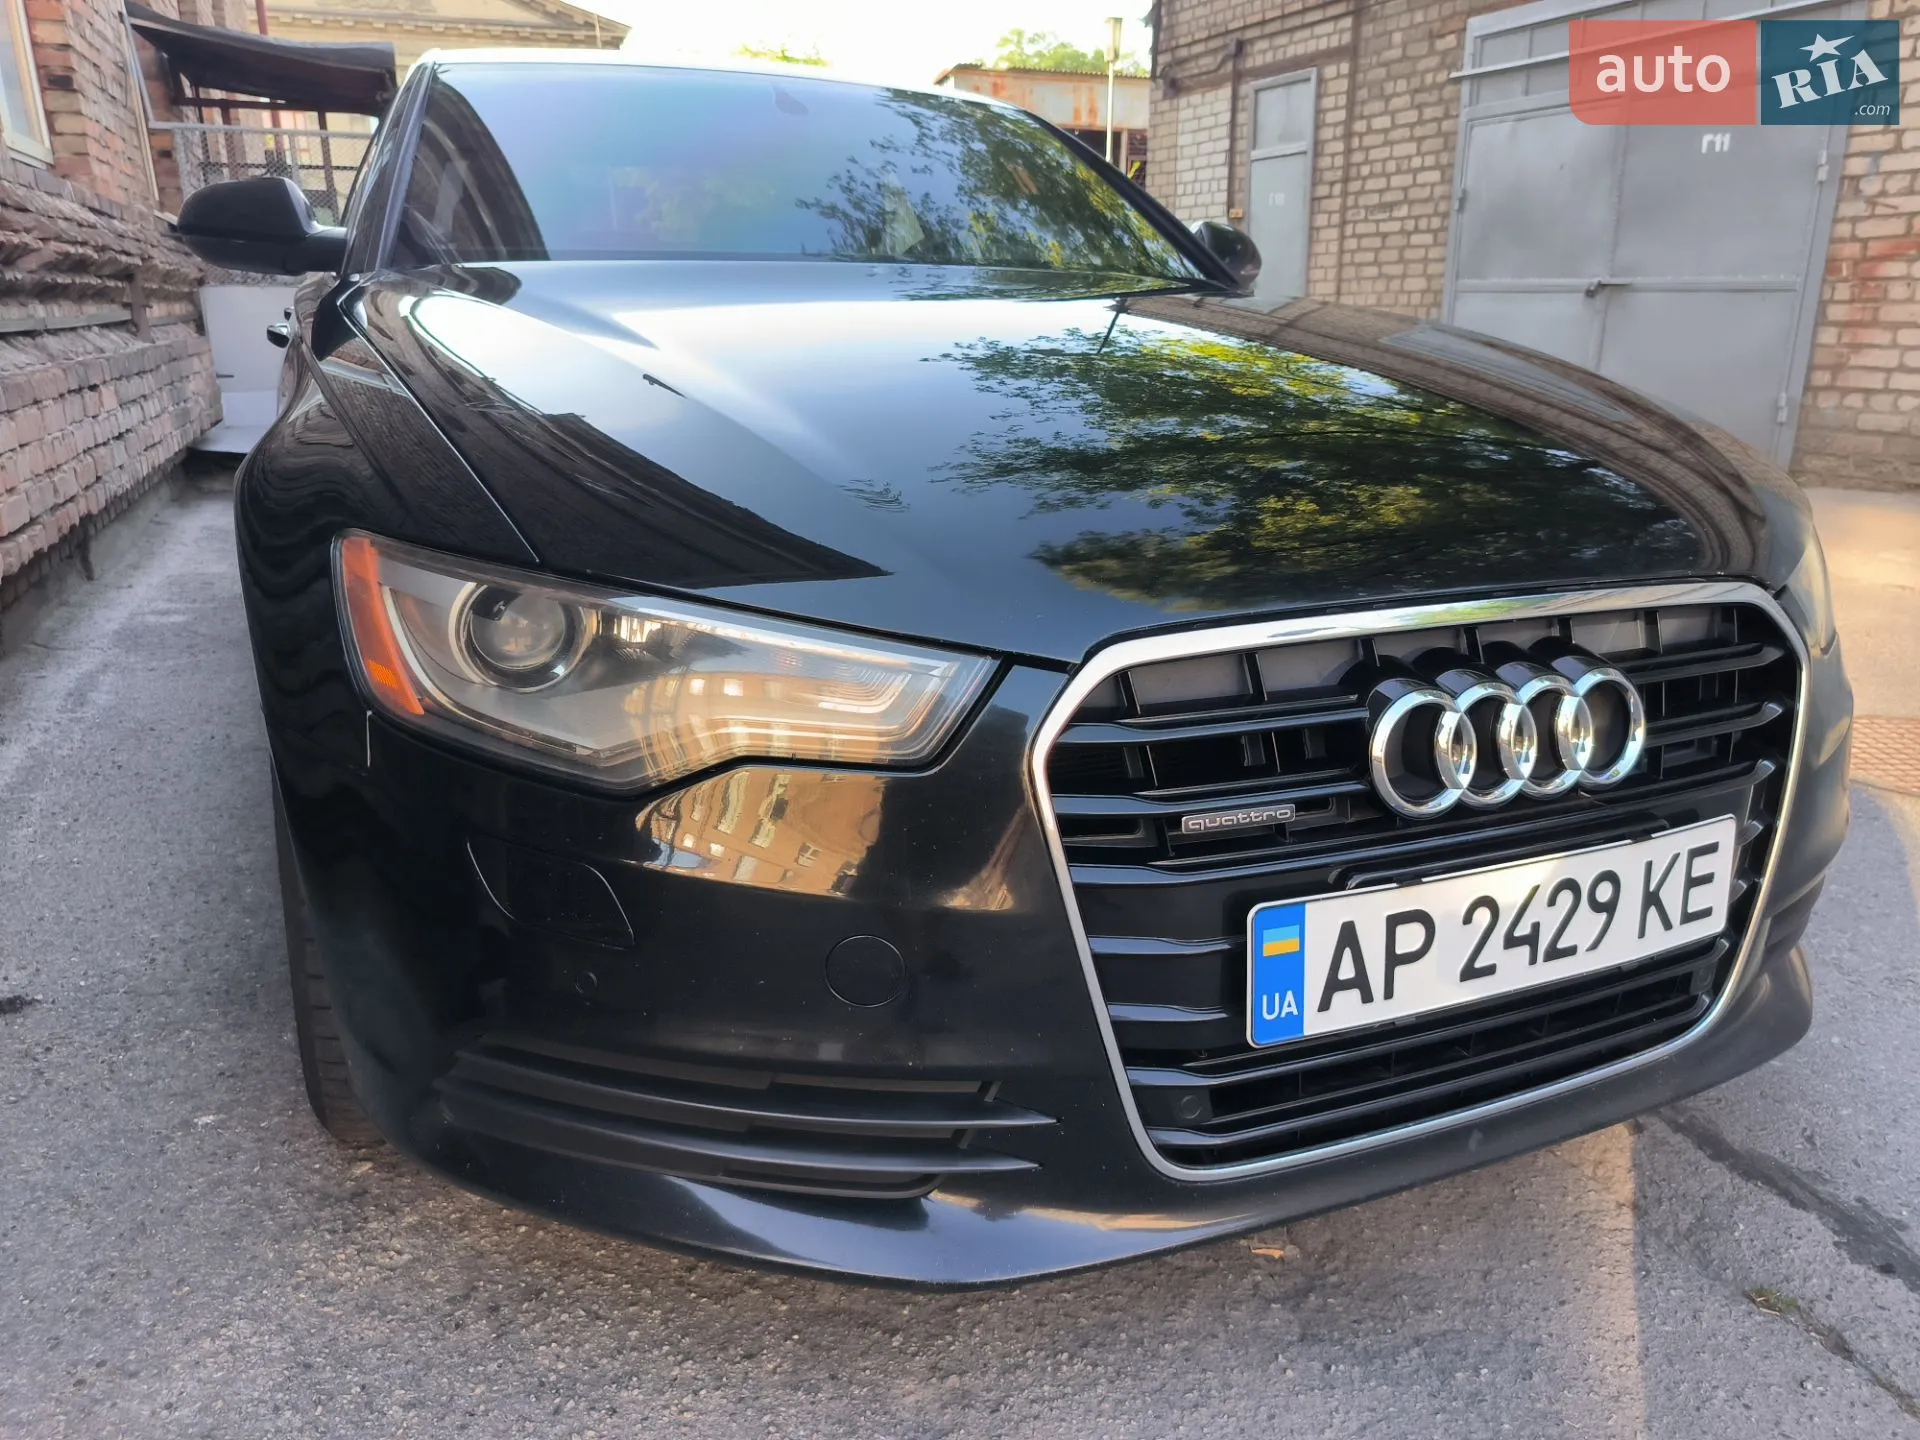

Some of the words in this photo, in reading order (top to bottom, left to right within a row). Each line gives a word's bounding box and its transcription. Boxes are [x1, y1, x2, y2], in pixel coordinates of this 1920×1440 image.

[1188, 809, 1291, 831] quattro
[1316, 908, 1437, 1012] AP
[1458, 869, 1622, 983] 2429
[1637, 841, 1720, 940] KE
[1261, 989, 1299, 1021] UA
